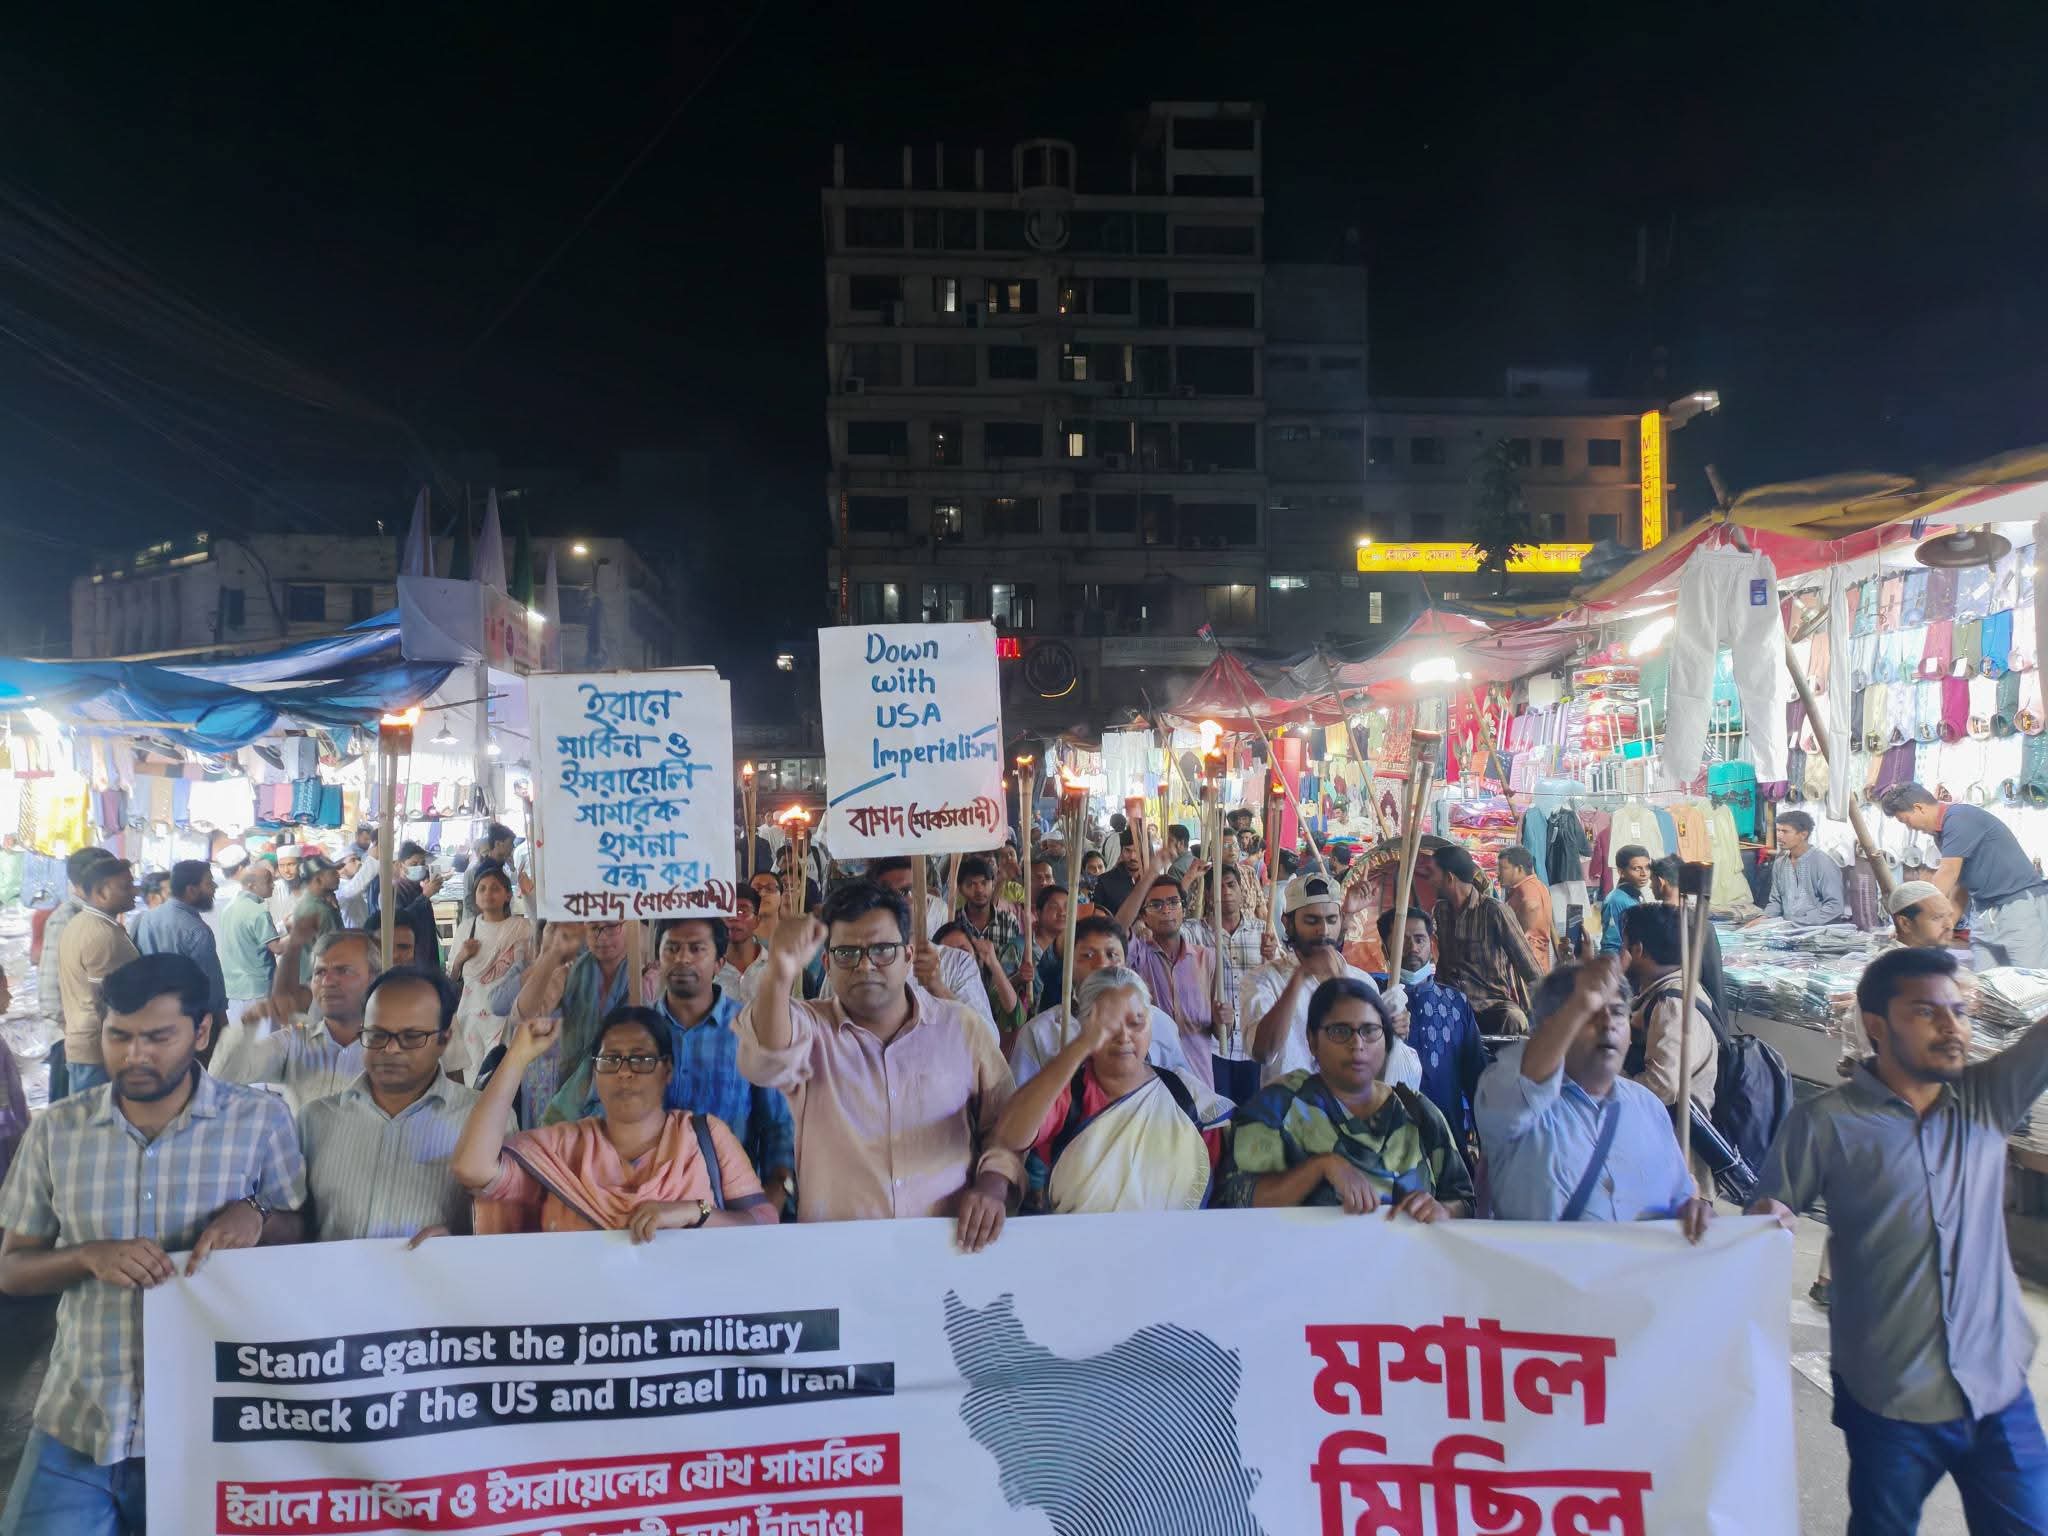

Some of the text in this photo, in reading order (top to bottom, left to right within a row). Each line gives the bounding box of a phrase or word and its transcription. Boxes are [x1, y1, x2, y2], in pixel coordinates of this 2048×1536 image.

[1642, 436, 1652, 549] MEGHNA
[864, 632, 939, 664] Down
[871, 667, 936, 694] with
[578, 683, 683, 733] ইরানে
[876, 702, 941, 728] USA
[557, 728, 692, 760] মার্কিন ও
[873, 734, 998, 778] Imperialism
[575, 796, 690, 833] সামরিক
[598, 829, 689, 862] হামলা
[237, 1317, 803, 1379] Stand against the joint military
[1305, 1316, 1617, 1426] মশাল
[238, 1399, 352, 1433] attack
[365, 1391, 408, 1431] of
[419, 1386, 478, 1424] the
[491, 1381, 538, 1415] US
[550, 1379, 615, 1412] and
[628, 1368, 724, 1409] Israel
[736, 1367, 767, 1400] in
[225, 1439, 887, 1527] ইরানে মার্কিন ও ইসরায়েলের যৌথ সামরিক
[1310, 1430, 1654, 1536] মিছিল
